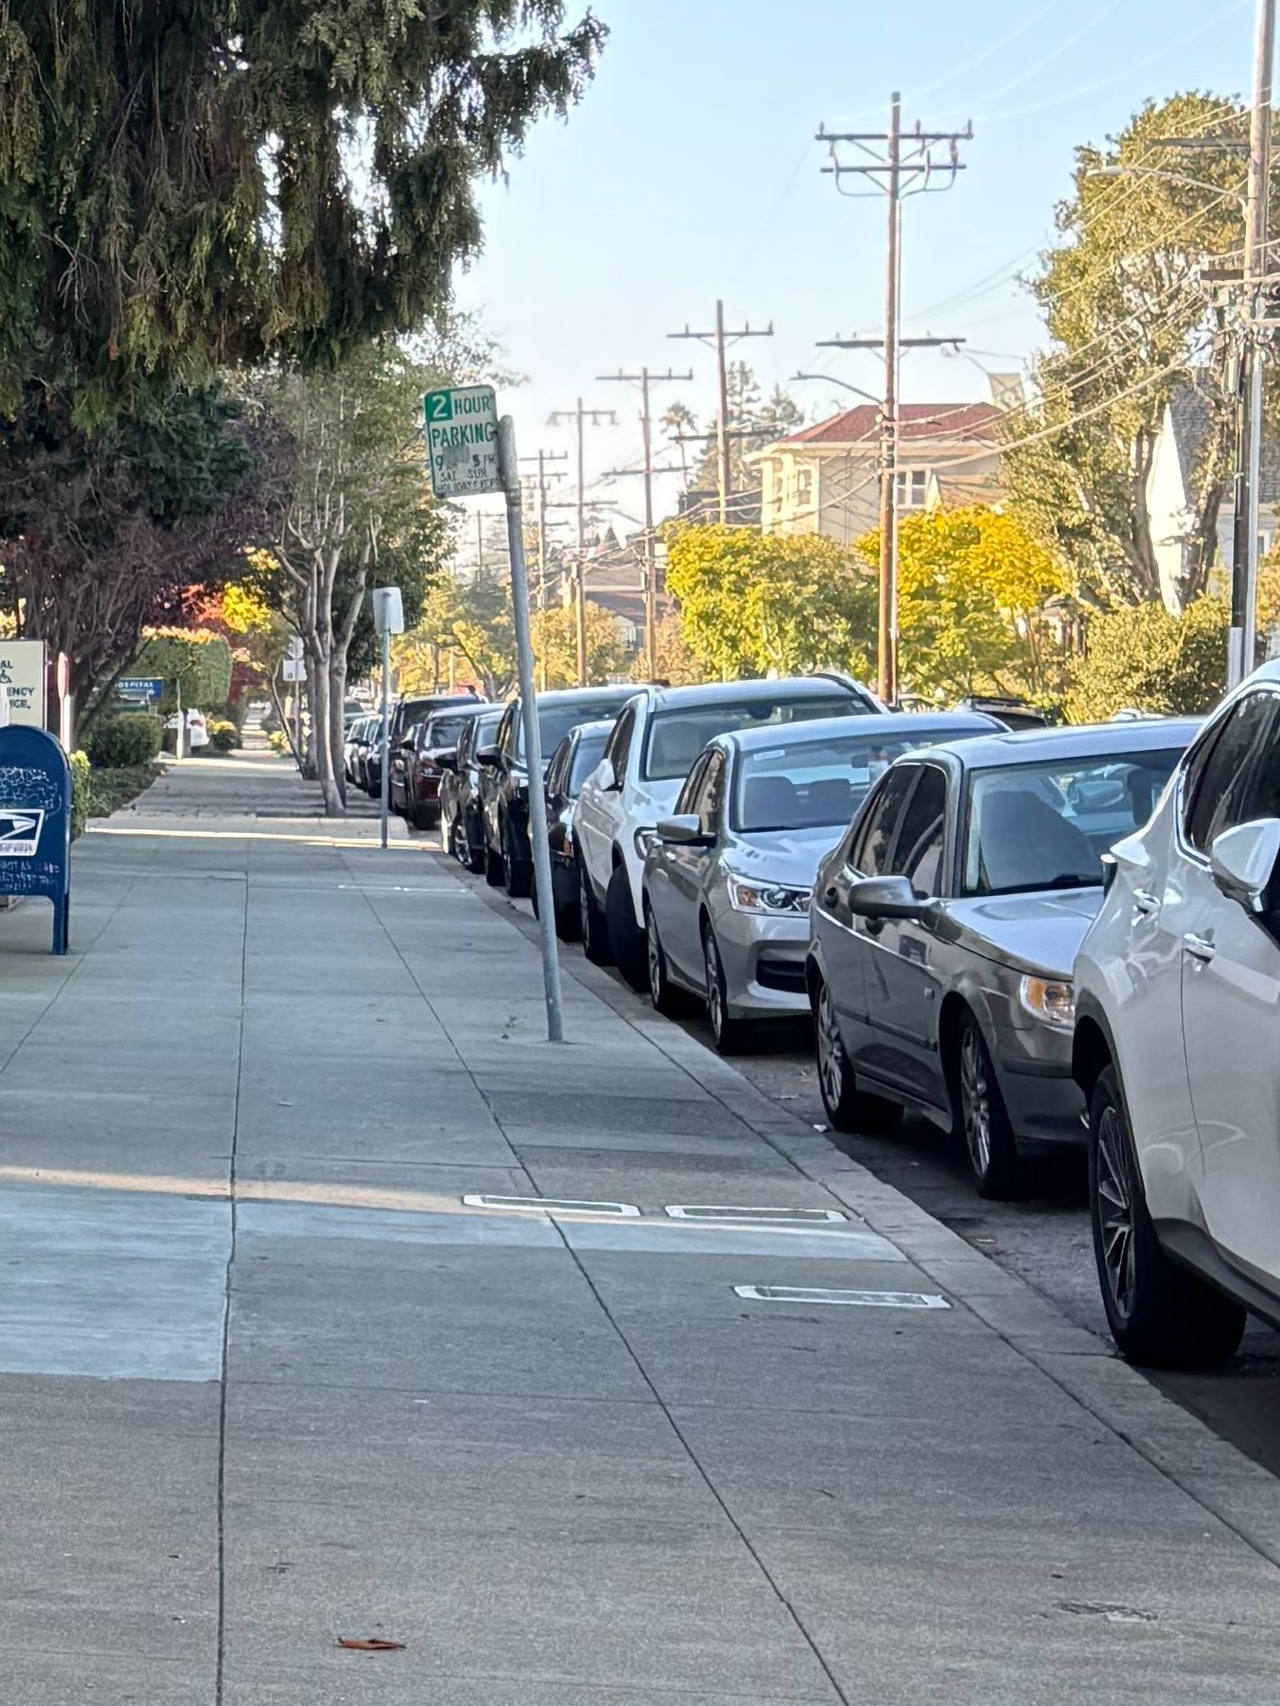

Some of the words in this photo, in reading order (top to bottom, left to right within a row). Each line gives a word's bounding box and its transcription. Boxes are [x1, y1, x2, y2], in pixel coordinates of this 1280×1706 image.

[432, 395, 448, 418] 2
[454, 396, 491, 415] HOUR
[432, 422, 495, 448] PARKING
